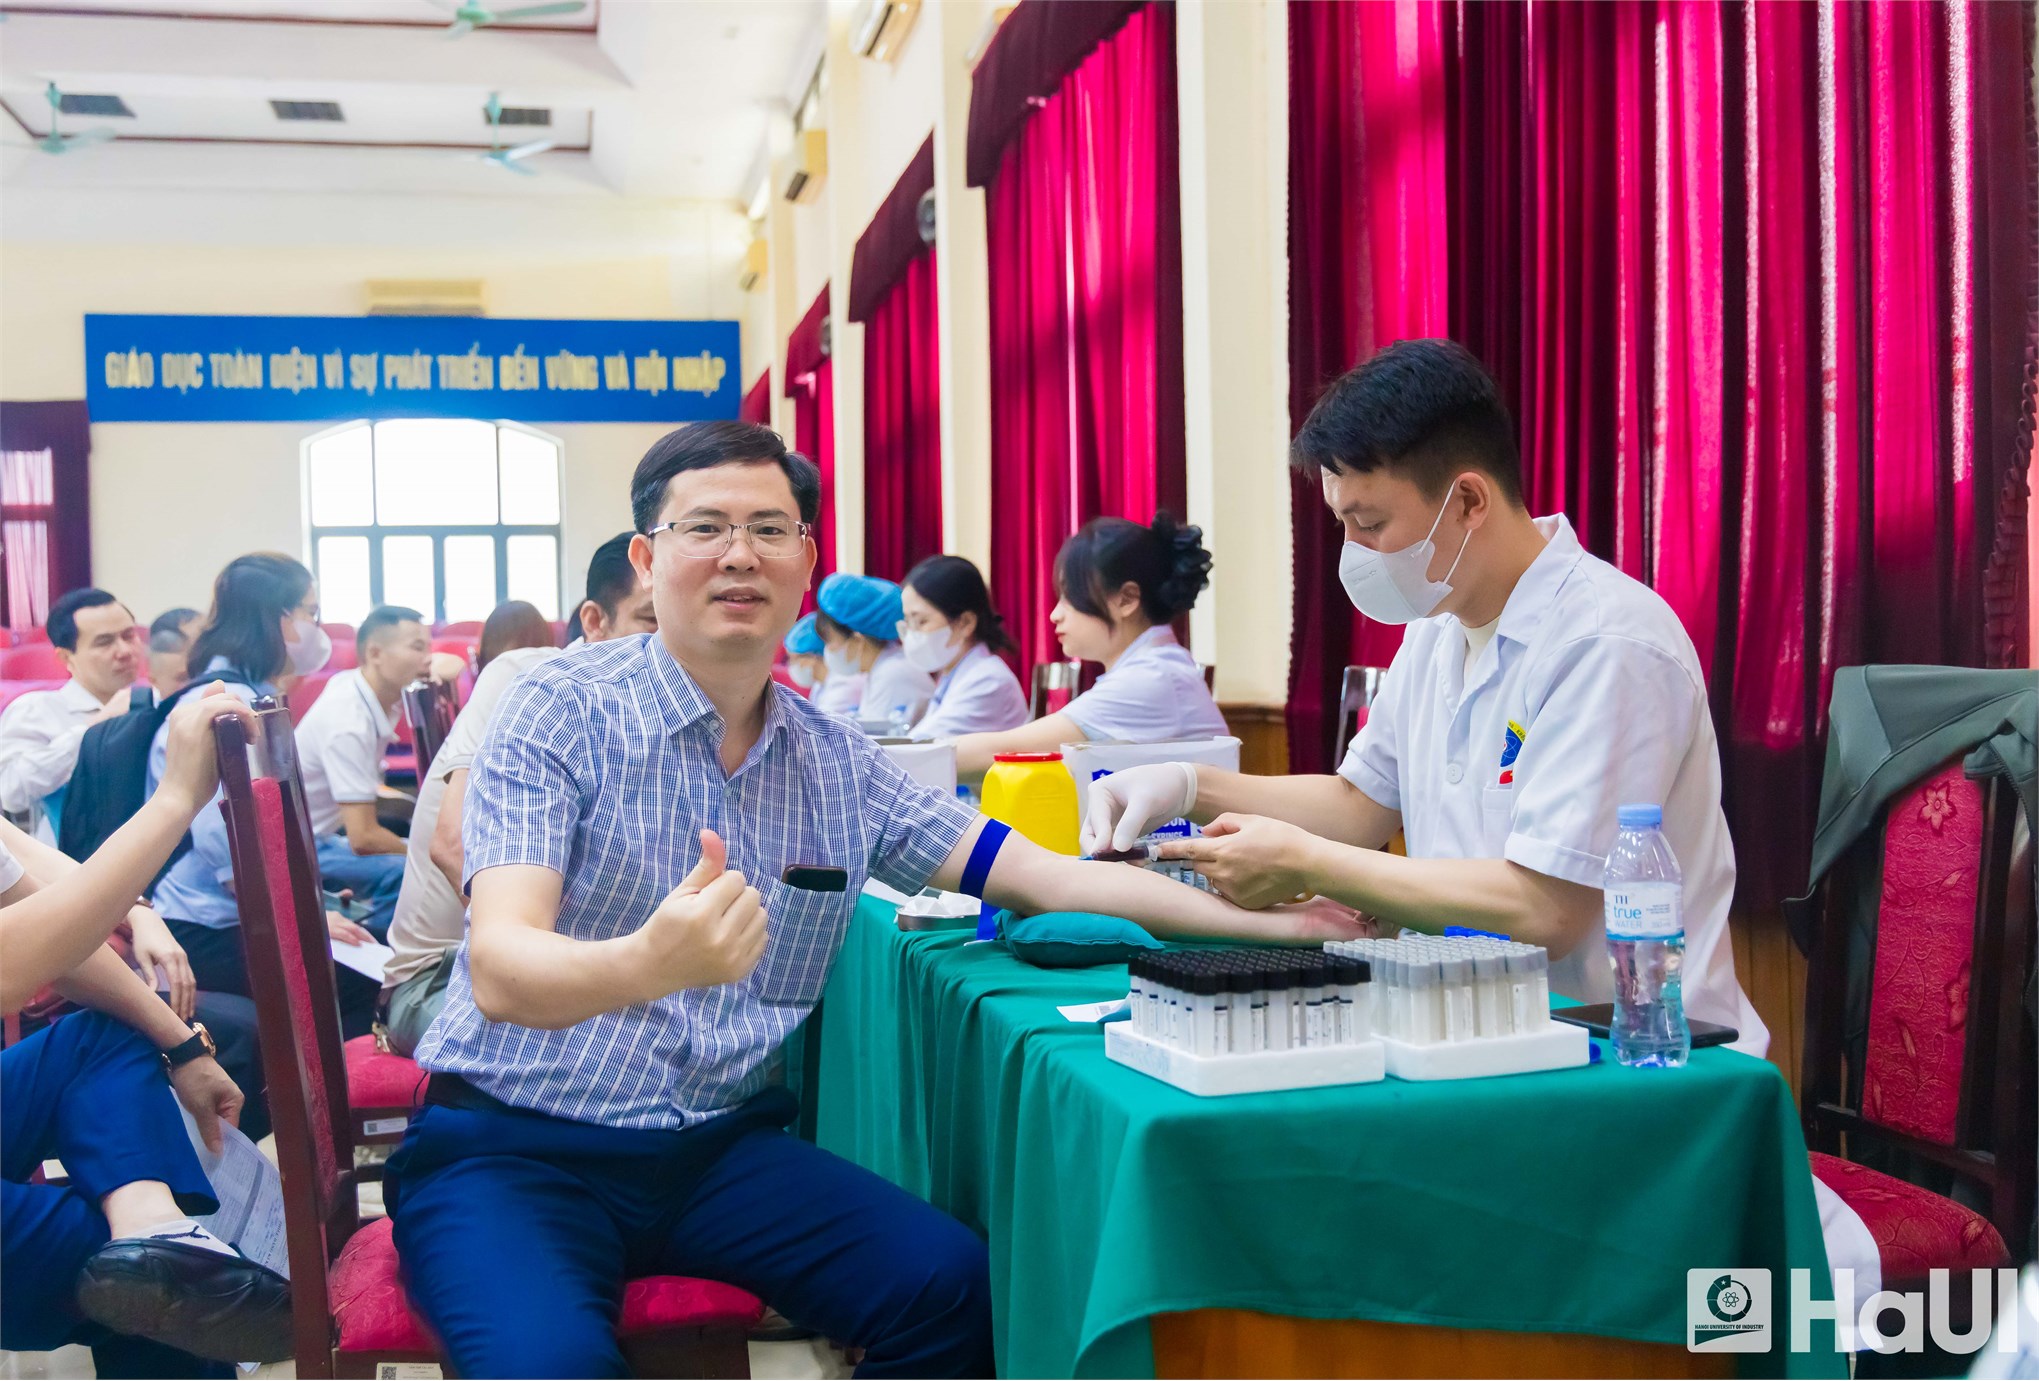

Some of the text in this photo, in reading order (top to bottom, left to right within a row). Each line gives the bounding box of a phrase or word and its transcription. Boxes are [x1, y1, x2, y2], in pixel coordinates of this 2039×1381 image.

[105, 347, 154, 388] GIÁO
[162, 352, 203, 395] DỤC
[350, 352, 378, 396] SỰ
[1613, 905, 1641, 919] true
[1615, 920, 1642, 929] WATER
